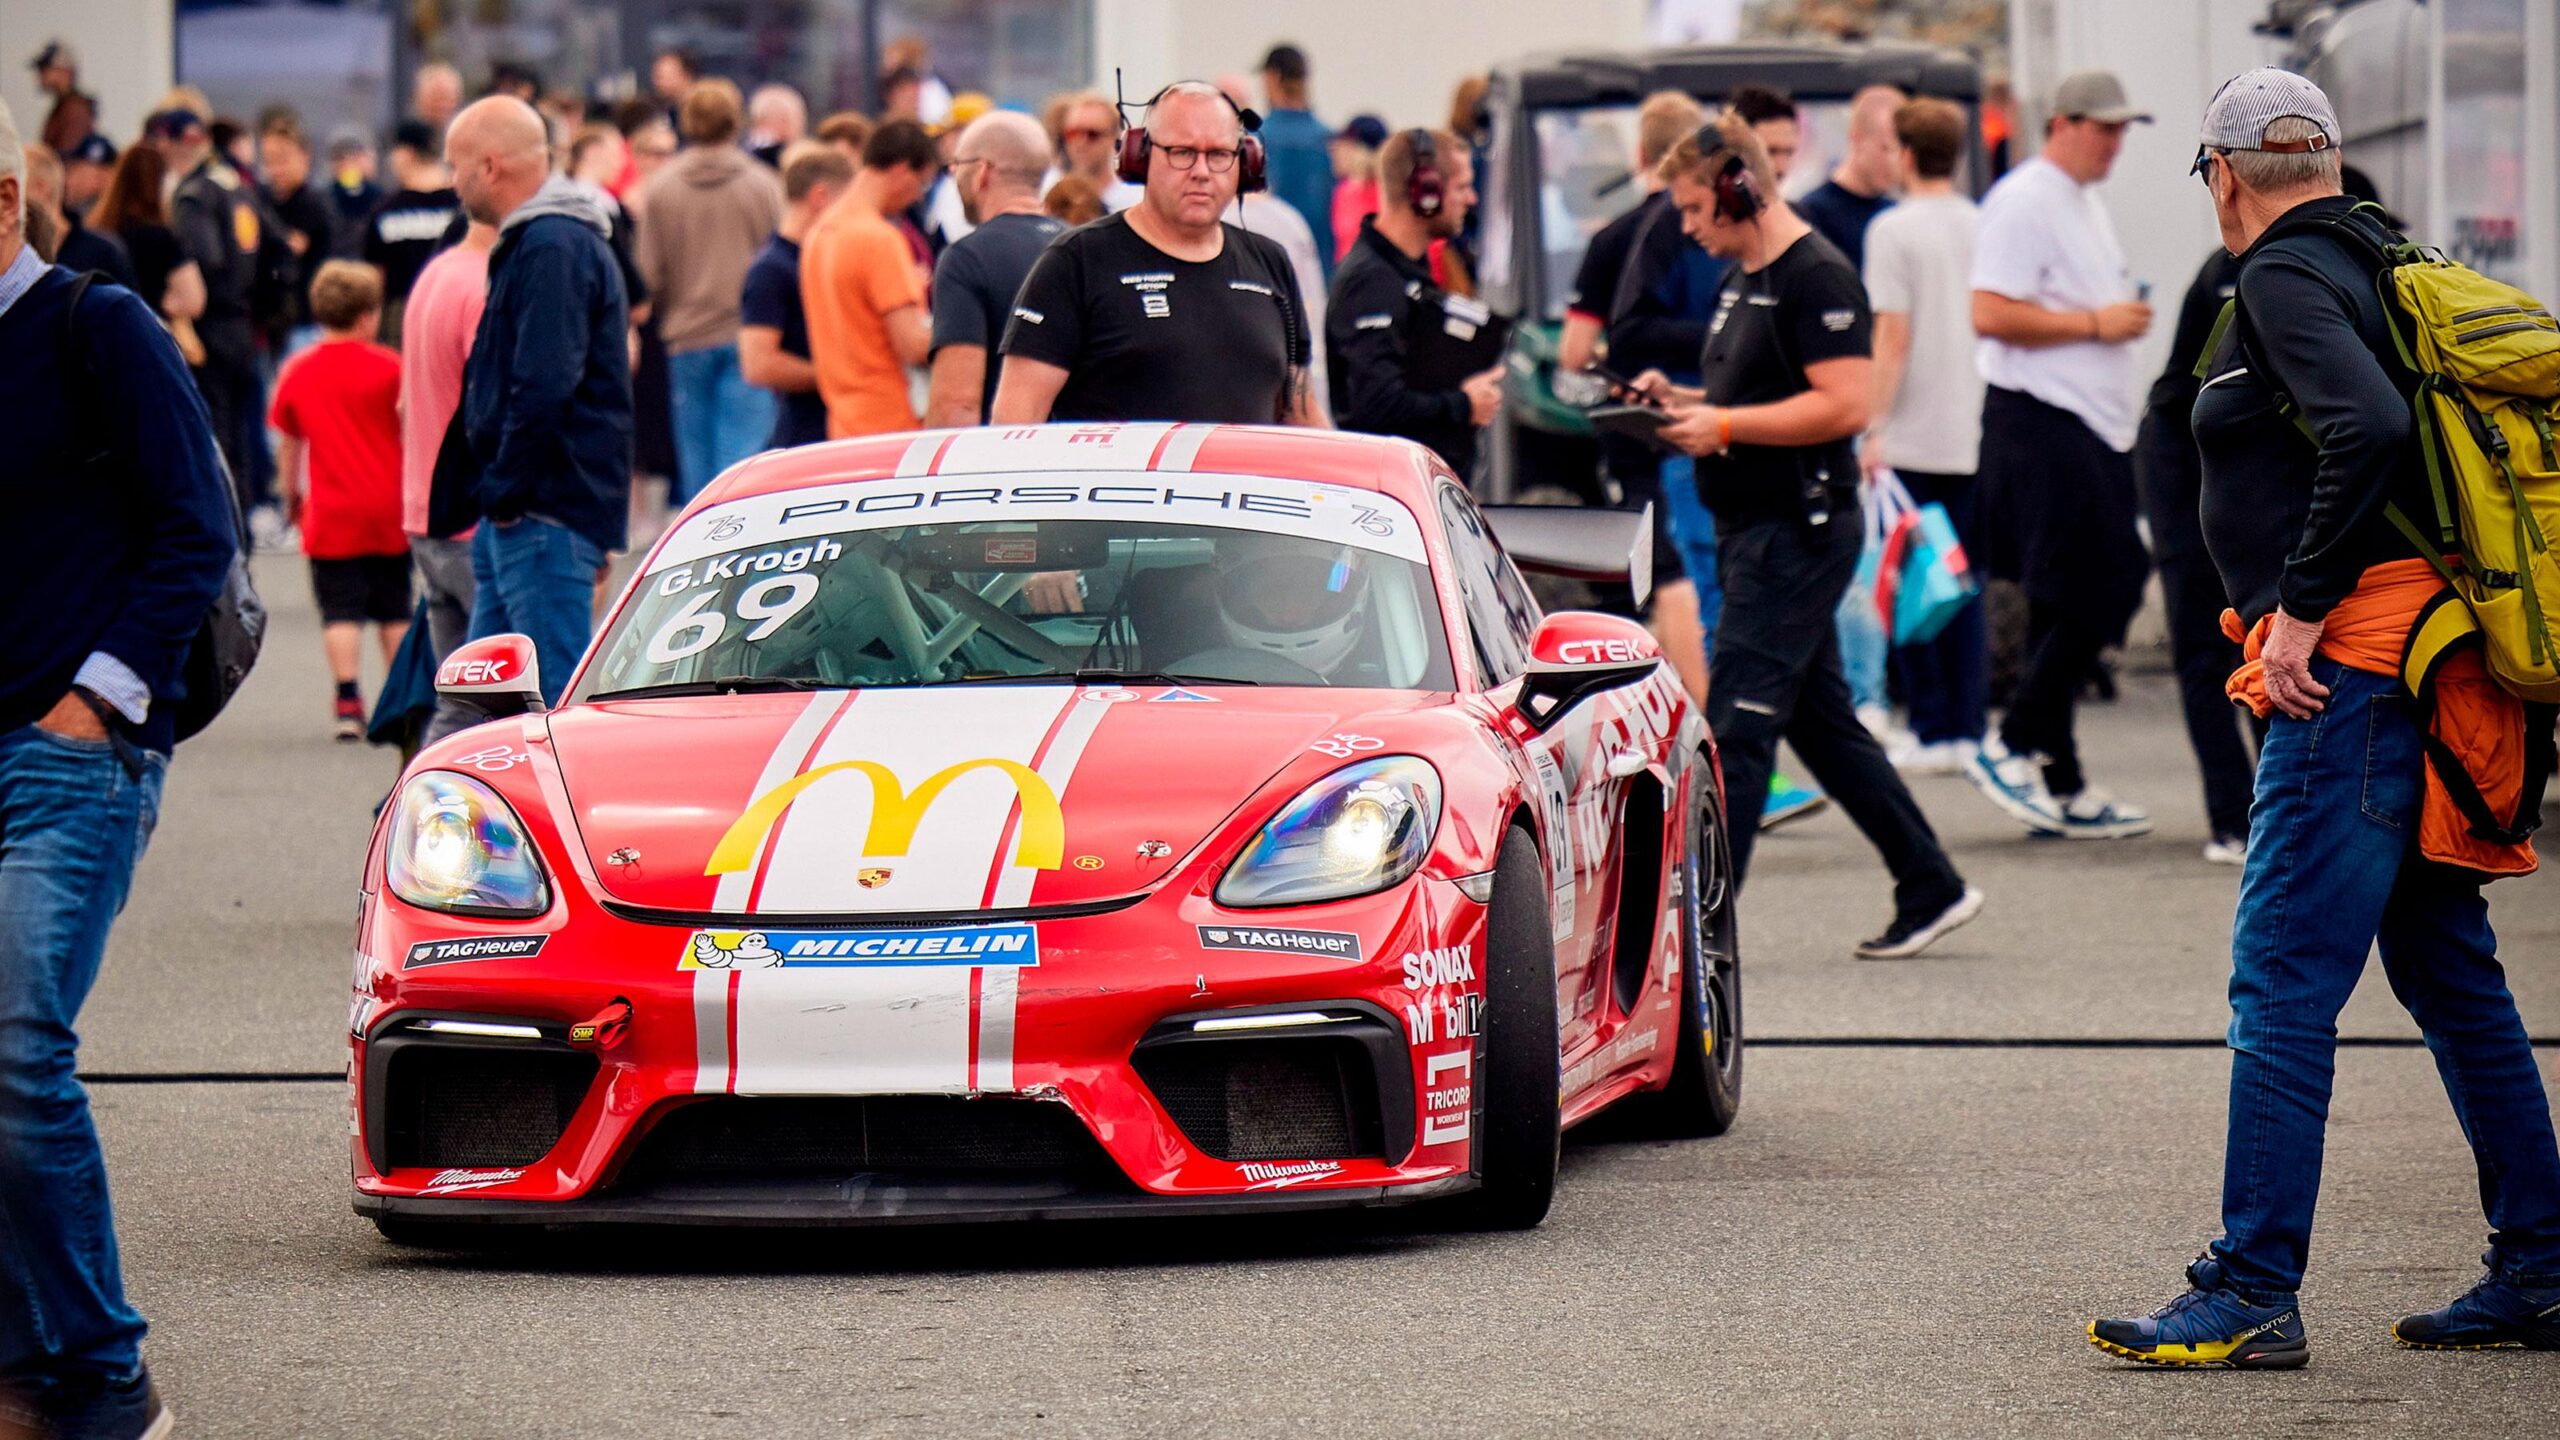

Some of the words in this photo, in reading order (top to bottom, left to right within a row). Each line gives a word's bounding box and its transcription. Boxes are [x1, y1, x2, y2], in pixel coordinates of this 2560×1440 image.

[779, 486, 1311, 525] PORSCHE
[703, 515, 747, 541] 75
[1352, 504, 1394, 537] 75
[659, 537, 843, 598] G.Krogh
[646, 573, 820, 664] 69
[1559, 639, 1646, 664] CTEK
[440, 660, 508, 685] CTEK
[787, 934, 1029, 957] MICHELIN
[1402, 944, 1476, 991] SONAX
[1406, 995, 1466, 1046] Mbil
[1426, 1085, 1470, 1111] TRICORP
[1235, 1160, 1341, 1183] Milwaukee
